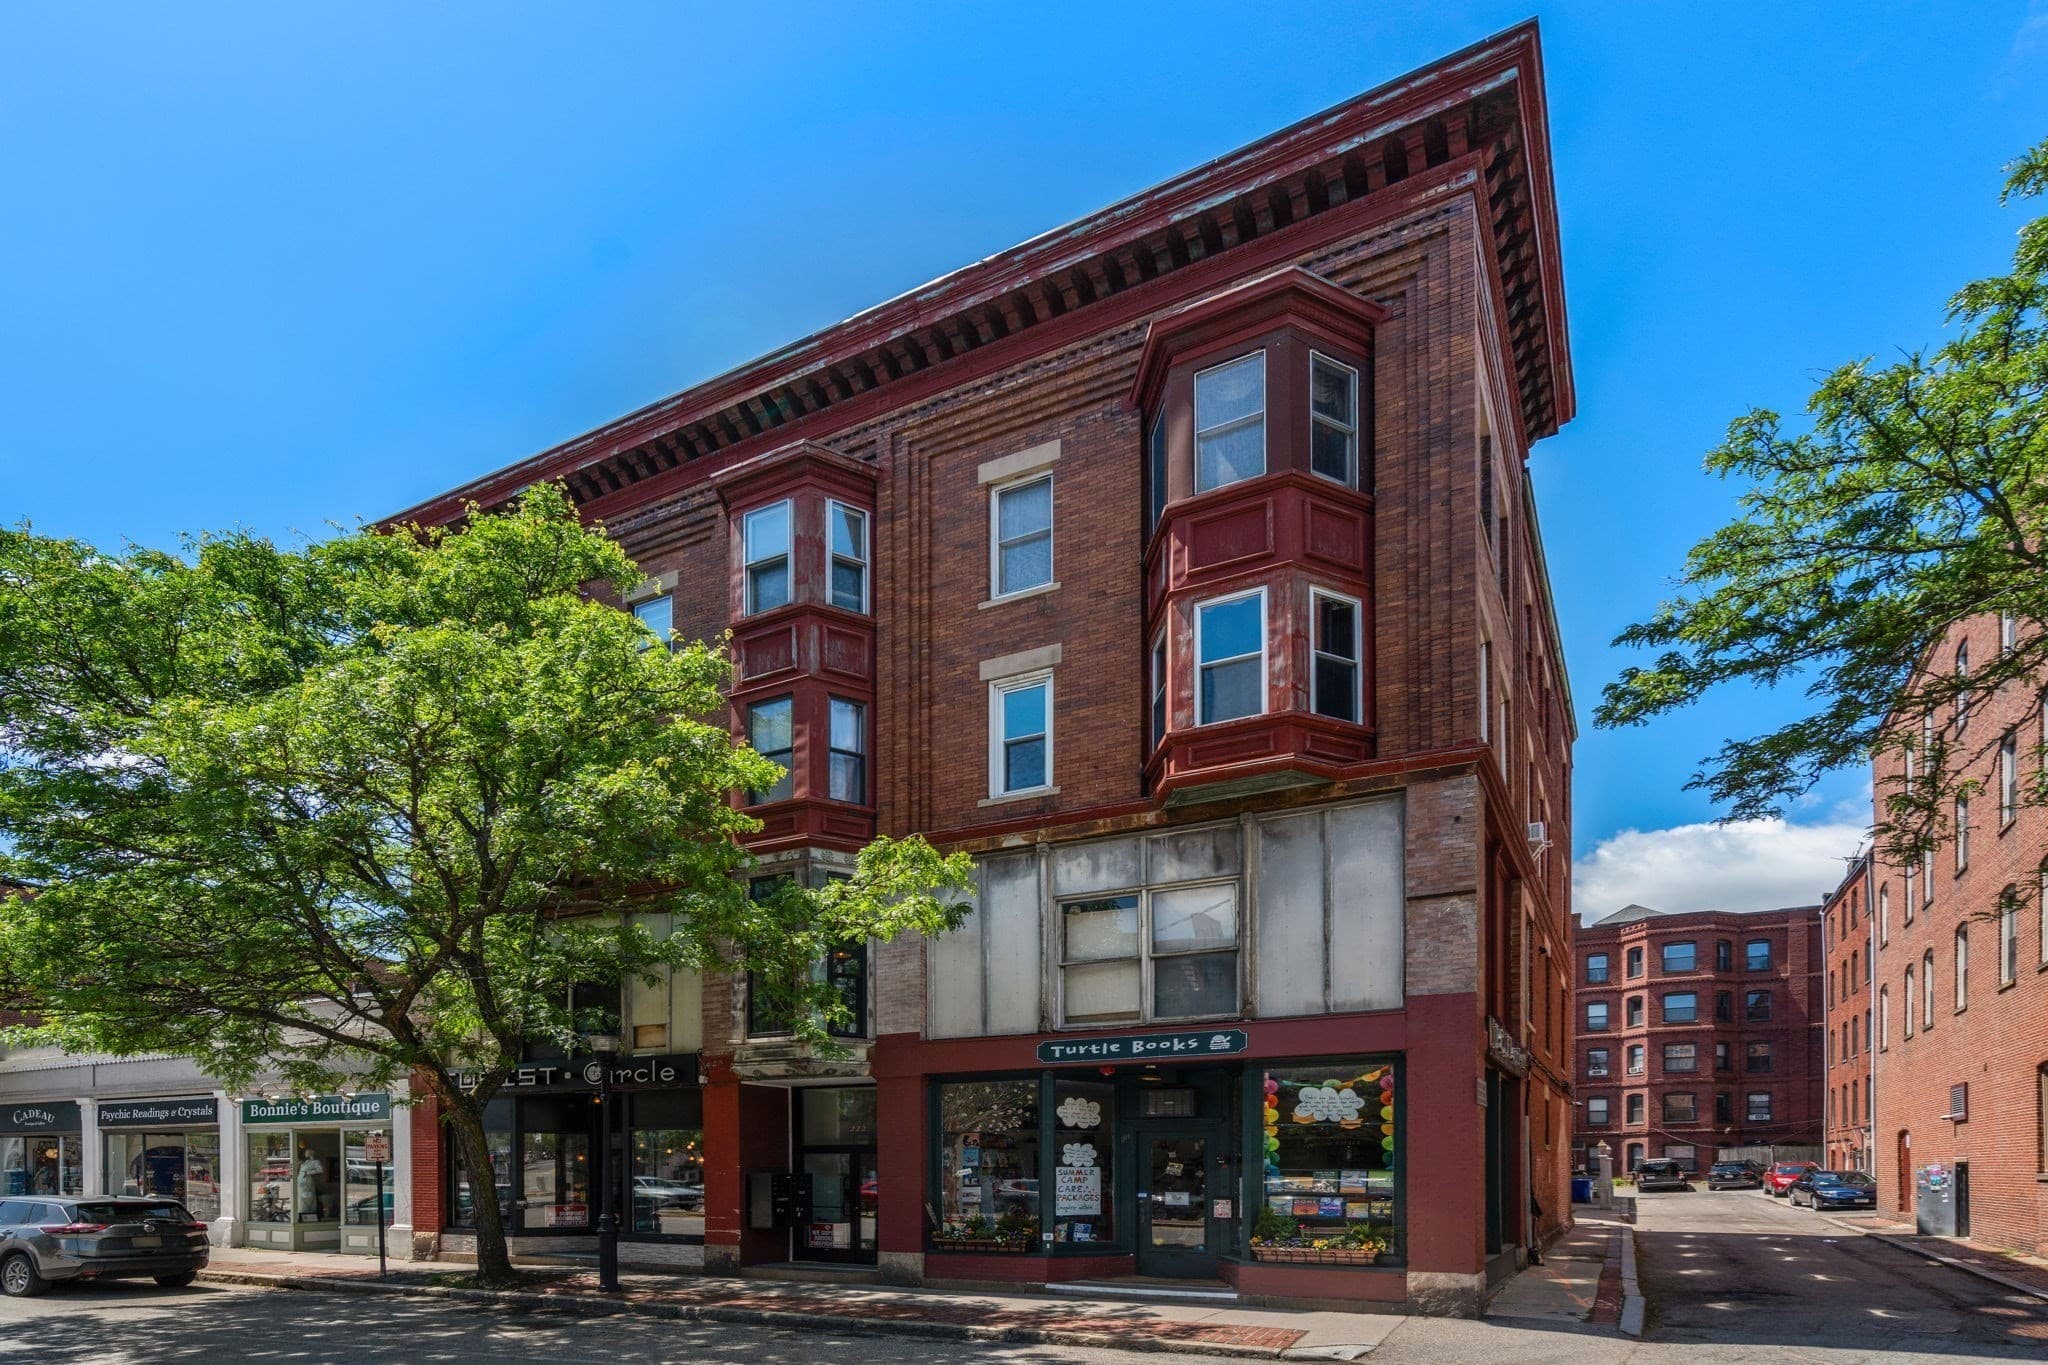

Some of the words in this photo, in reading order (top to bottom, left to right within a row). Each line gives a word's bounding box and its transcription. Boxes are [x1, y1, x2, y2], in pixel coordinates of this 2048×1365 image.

[1051, 1042, 1121, 1058] Turtle
[1132, 1038, 1199, 1053] Books
[101, 1109, 131, 1122] Psychic
[132, 1107, 169, 1120] Readings
[178, 1104, 213, 1118] Crystals
[250, 1103, 308, 1117] Bonnie's
[312, 1101, 380, 1116] Boutique
[1061, 1176, 1088, 1184] CAMP
